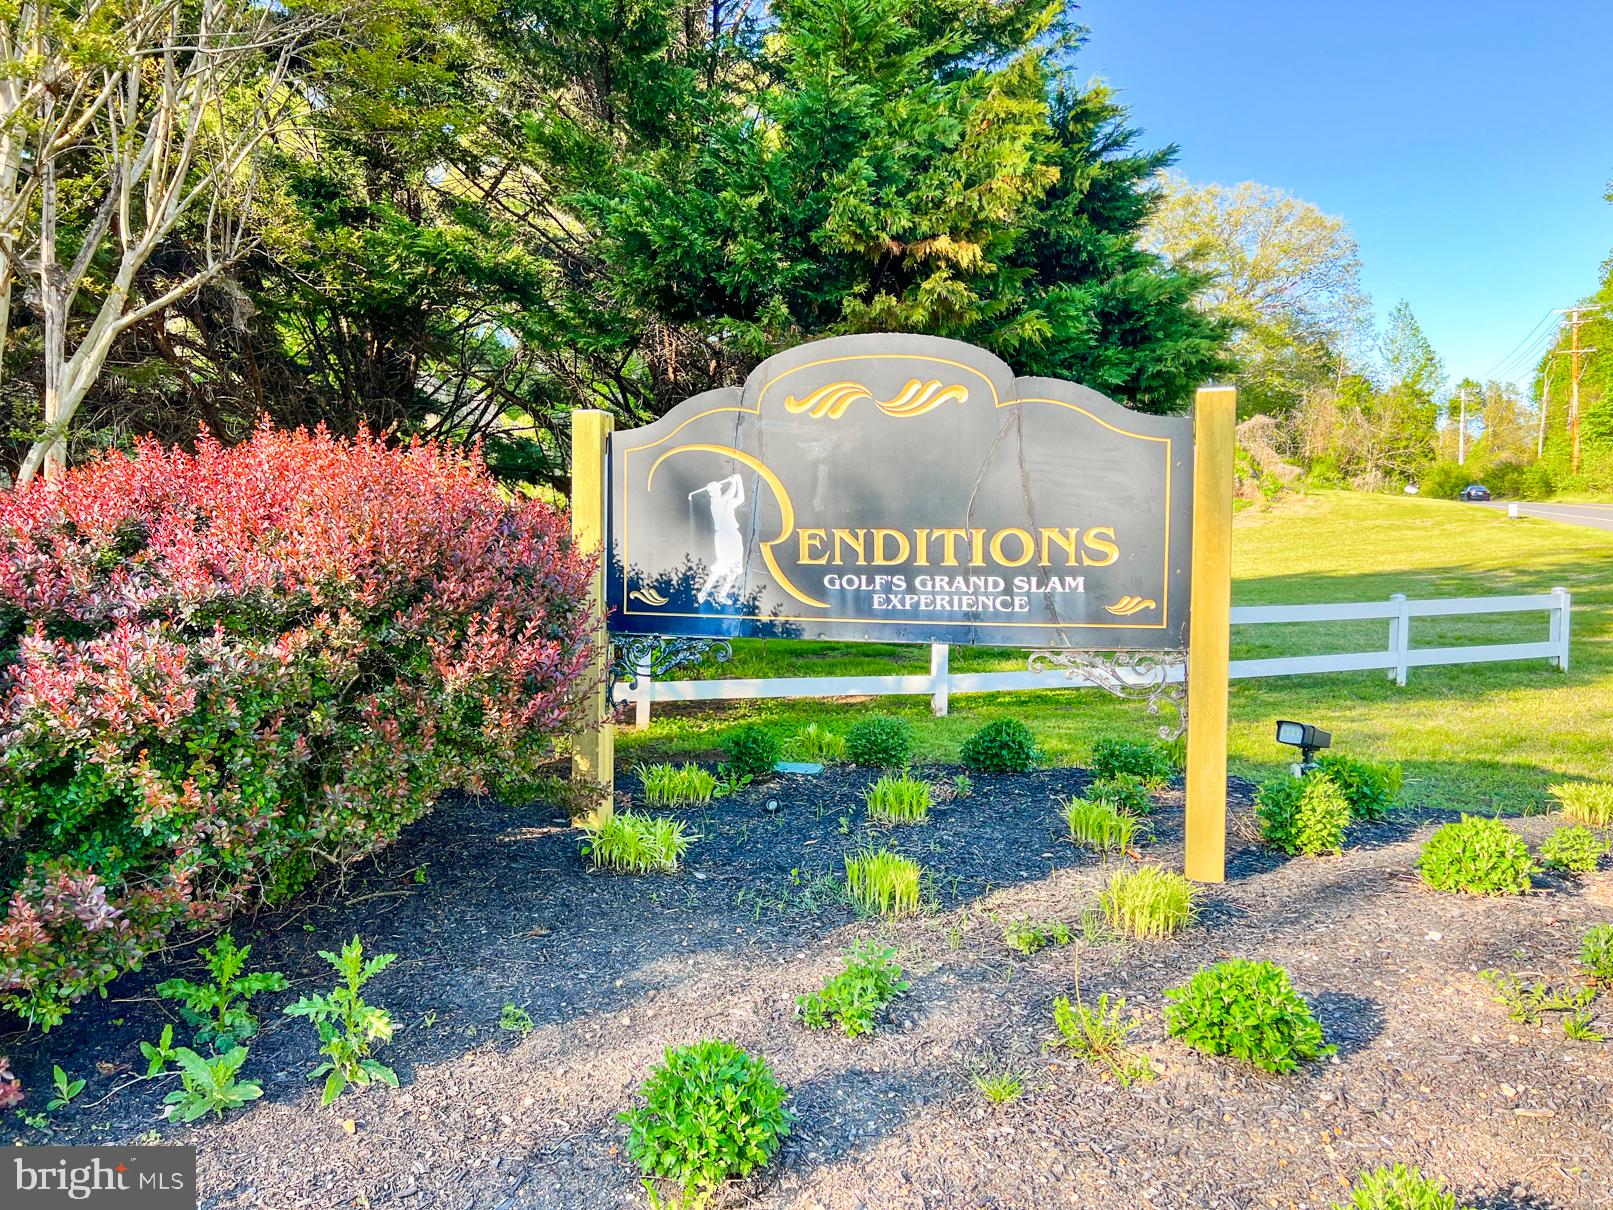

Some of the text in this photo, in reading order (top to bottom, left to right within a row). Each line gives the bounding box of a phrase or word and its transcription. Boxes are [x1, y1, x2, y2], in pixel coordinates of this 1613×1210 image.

[647, 444, 1121, 609] RENDITIONS
[822, 573, 1086, 593] GOLF'S GRAND SLAM
[871, 593, 1030, 612] EXPERIENCE
